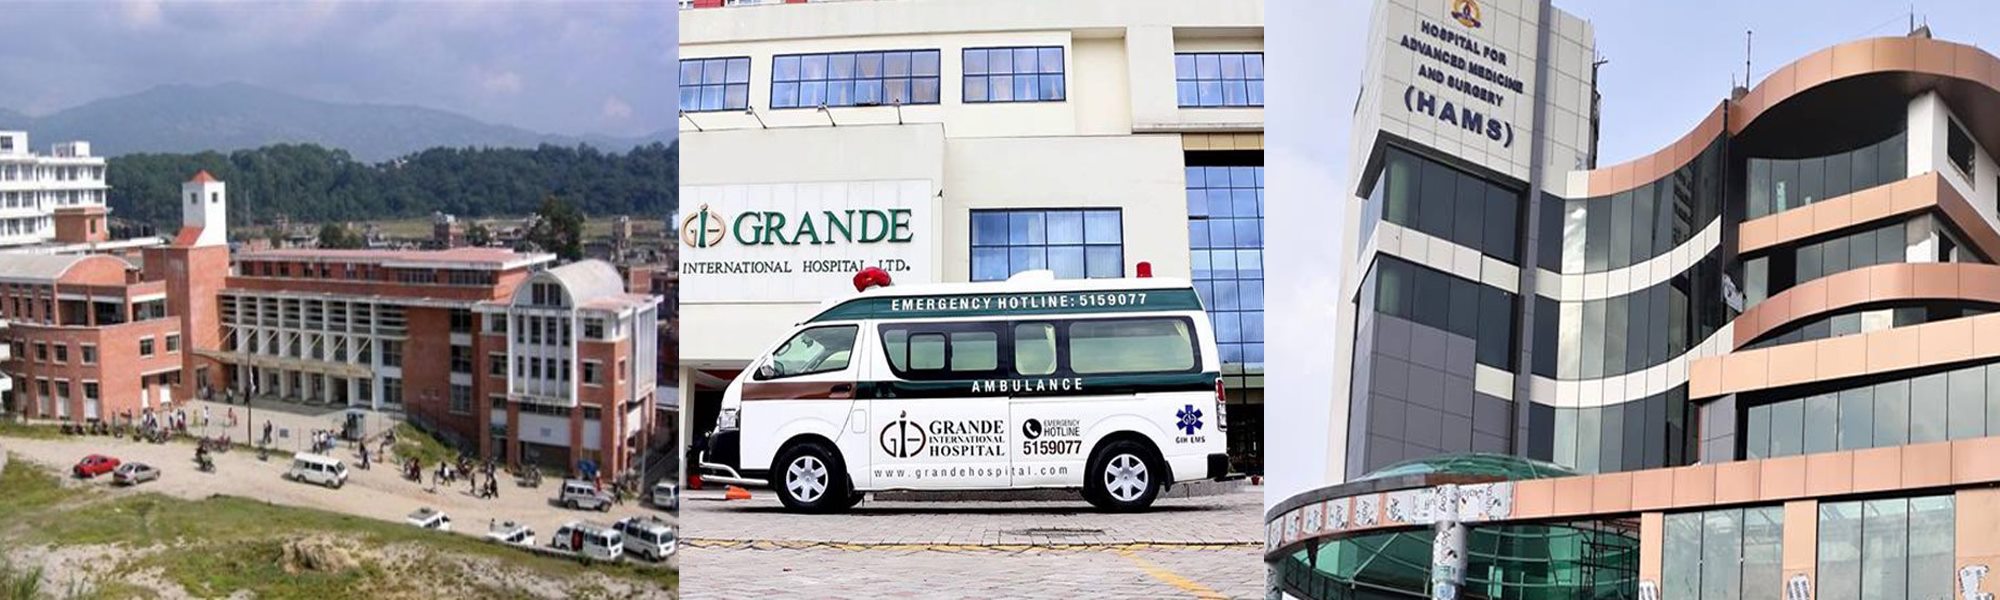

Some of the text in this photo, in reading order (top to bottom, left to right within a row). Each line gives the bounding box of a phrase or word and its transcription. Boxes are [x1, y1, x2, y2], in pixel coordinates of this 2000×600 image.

[1421, 20, 1507, 65] HOSPITAL FOR
[1400, 35, 1523, 94] ADVANCED MEDICINE
[1418, 64, 1504, 107] AND SURGERY
[1404, 85, 1514, 148] (HAMS)
[733, 208, 914, 246] GRANDE
[682, 261, 792, 275] INTERNATIONAL
[891, 294, 1148, 311] EMERGENCY HOTLINE: 5159077
[971, 378, 1084, 393] AMBULANCE
[929, 420, 1004, 434] GRANDE
[1043, 419, 1080, 427] EMERGENCY
[1044, 426, 1080, 437] HOTLINE
[929, 436, 1005, 444] INTERNATIONAL
[1023, 440, 1082, 455] 5159077
[929, 445, 1005, 457] HOSPITAL
[874, 465, 1068, 480] www.grandehospital.com
